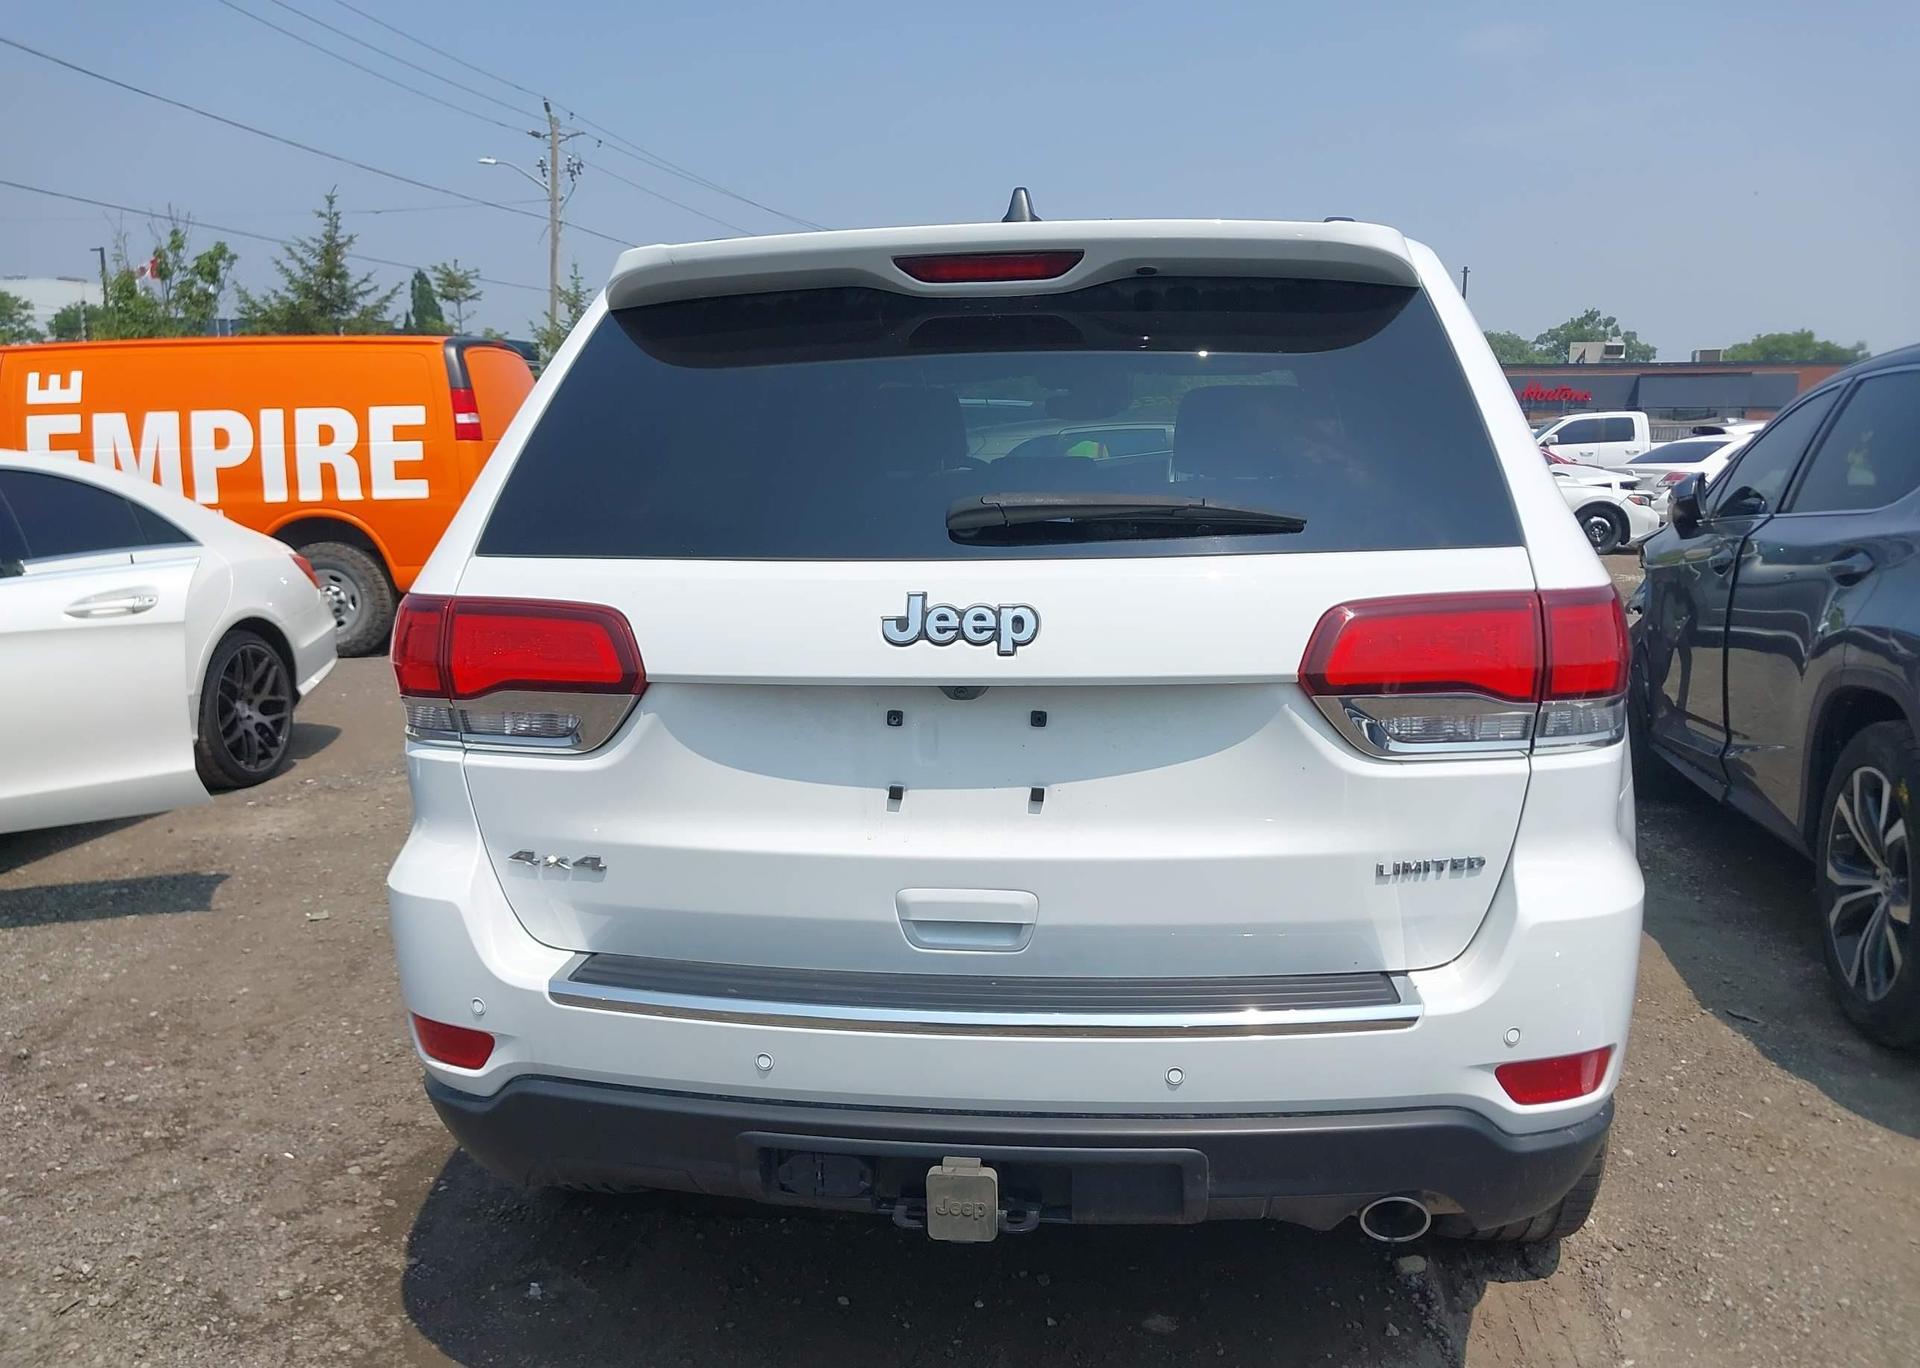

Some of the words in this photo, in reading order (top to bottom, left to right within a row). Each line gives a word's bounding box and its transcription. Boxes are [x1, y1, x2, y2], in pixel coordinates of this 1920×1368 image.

[881, 591, 1041, 656] Jeep
[1375, 856, 1486, 877] LIMITED
[936, 1197, 986, 1221] Jeep
